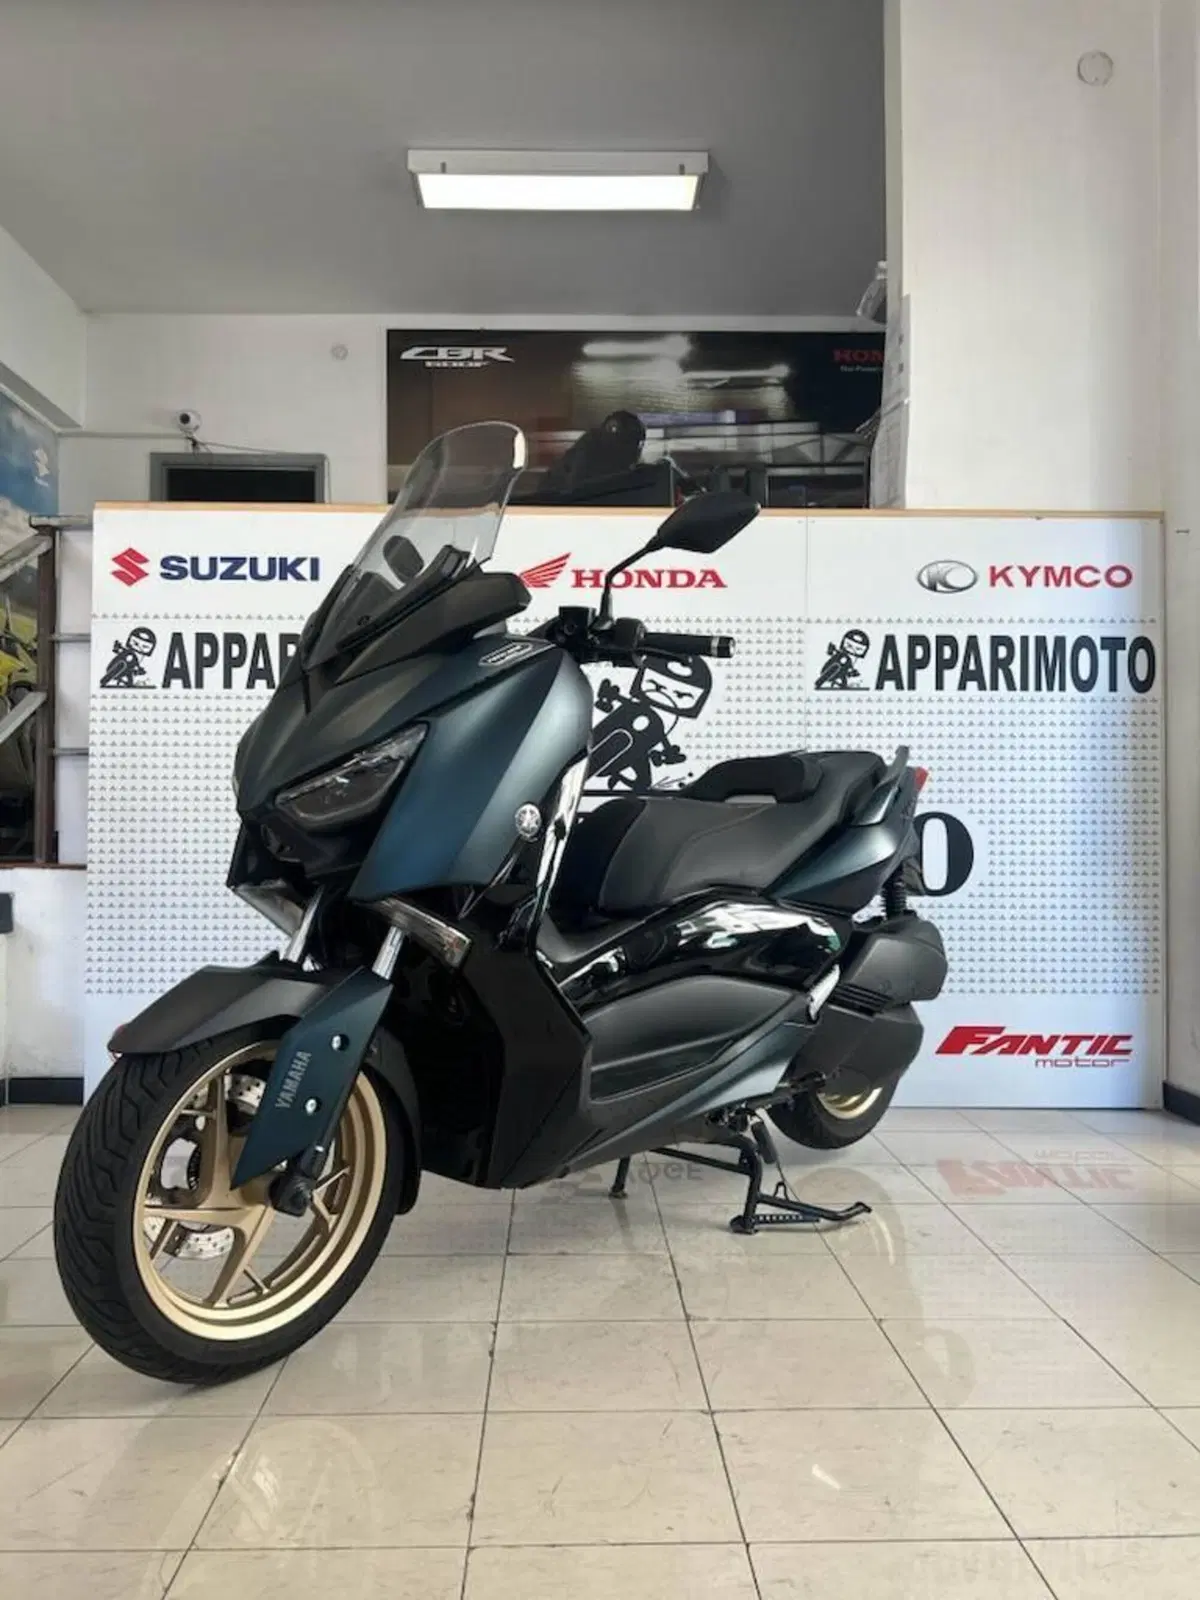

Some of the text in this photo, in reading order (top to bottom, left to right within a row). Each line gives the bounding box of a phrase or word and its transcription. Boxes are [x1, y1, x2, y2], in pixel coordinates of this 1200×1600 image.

[400, 346, 515, 362] CBR
[160, 555, 320, 581] SUZUKI
[571, 569, 728, 588] HONDA
[989, 565, 1133, 588] KYMCO
[875, 634, 1156, 693] APPARIMOTO
[935, 1026, 1133, 1055] FANTIC
[1035, 1057, 1130, 1068] motor
[275, 1051, 312, 1108] YAMAHA
